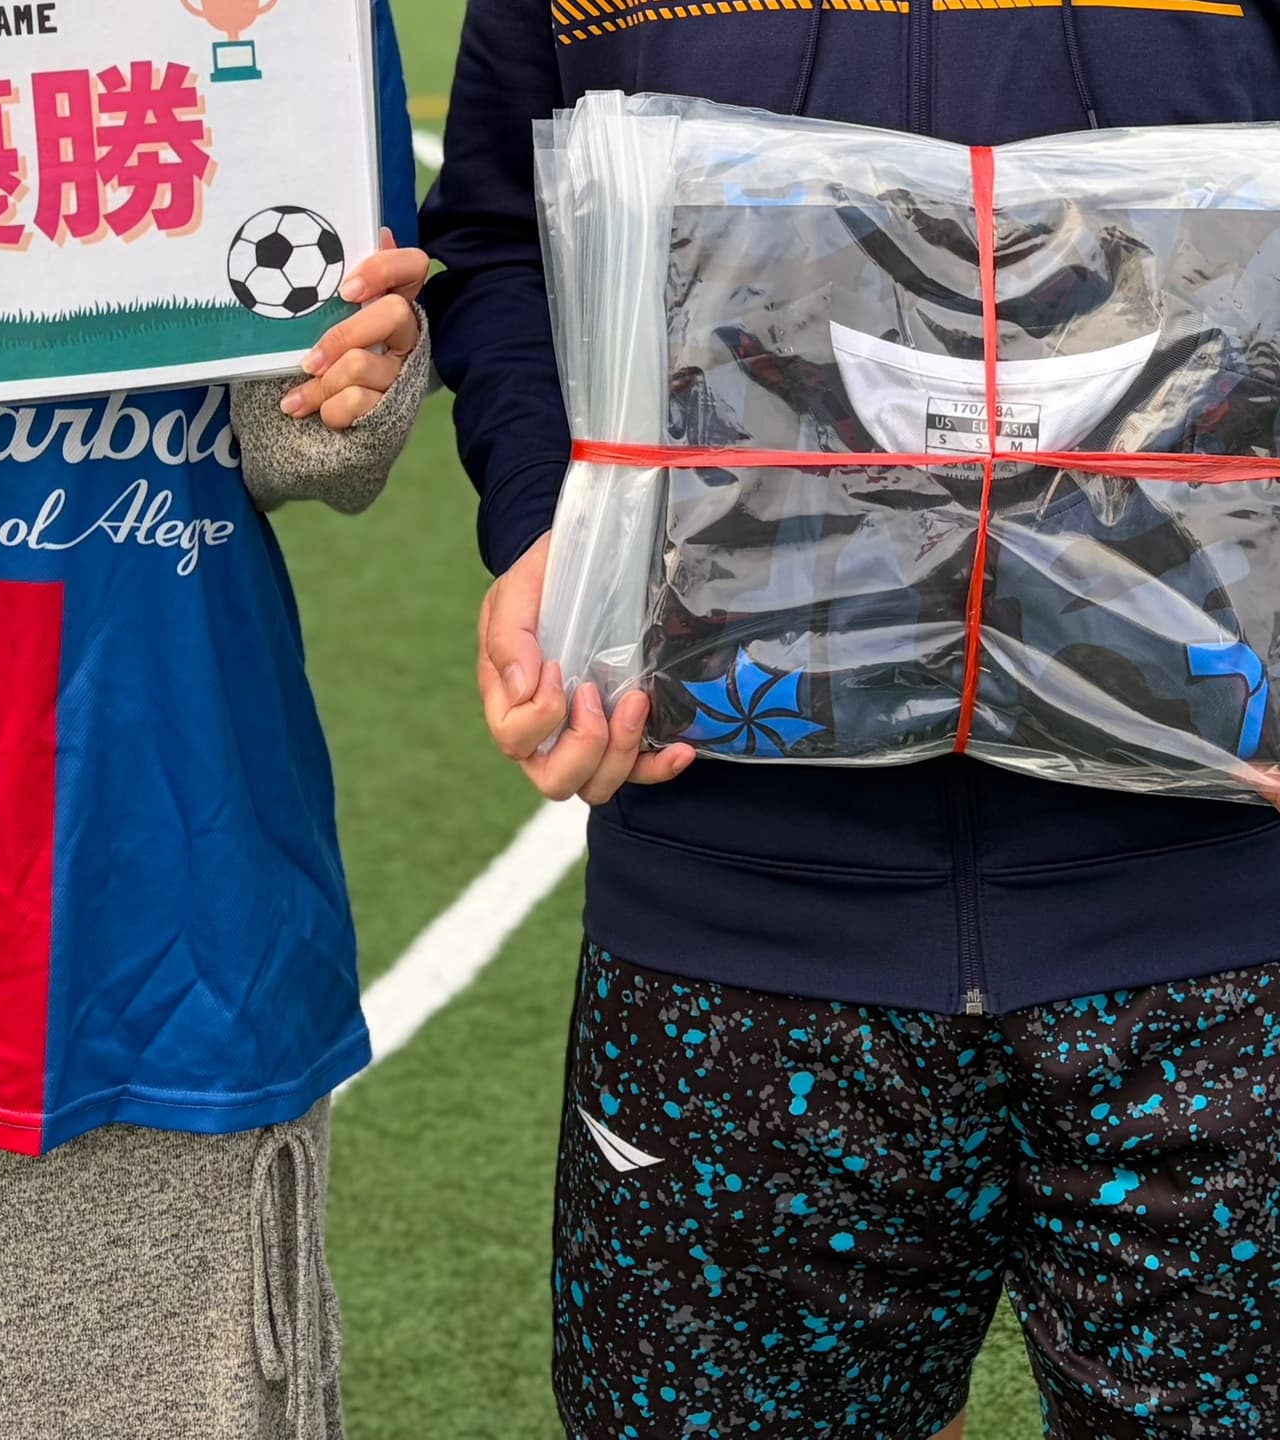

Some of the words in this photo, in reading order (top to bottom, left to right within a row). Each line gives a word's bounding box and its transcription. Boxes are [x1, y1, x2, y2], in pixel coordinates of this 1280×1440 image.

[952, 403, 1014, 418] 170/8A
[935, 416, 952, 429] US
[972, 420, 988, 432] EU
[1003, 424, 1032, 436] ASIA
[939, 434, 947, 444] S
[975, 438, 984, 449] S
[1010, 441, 1023, 451] M
